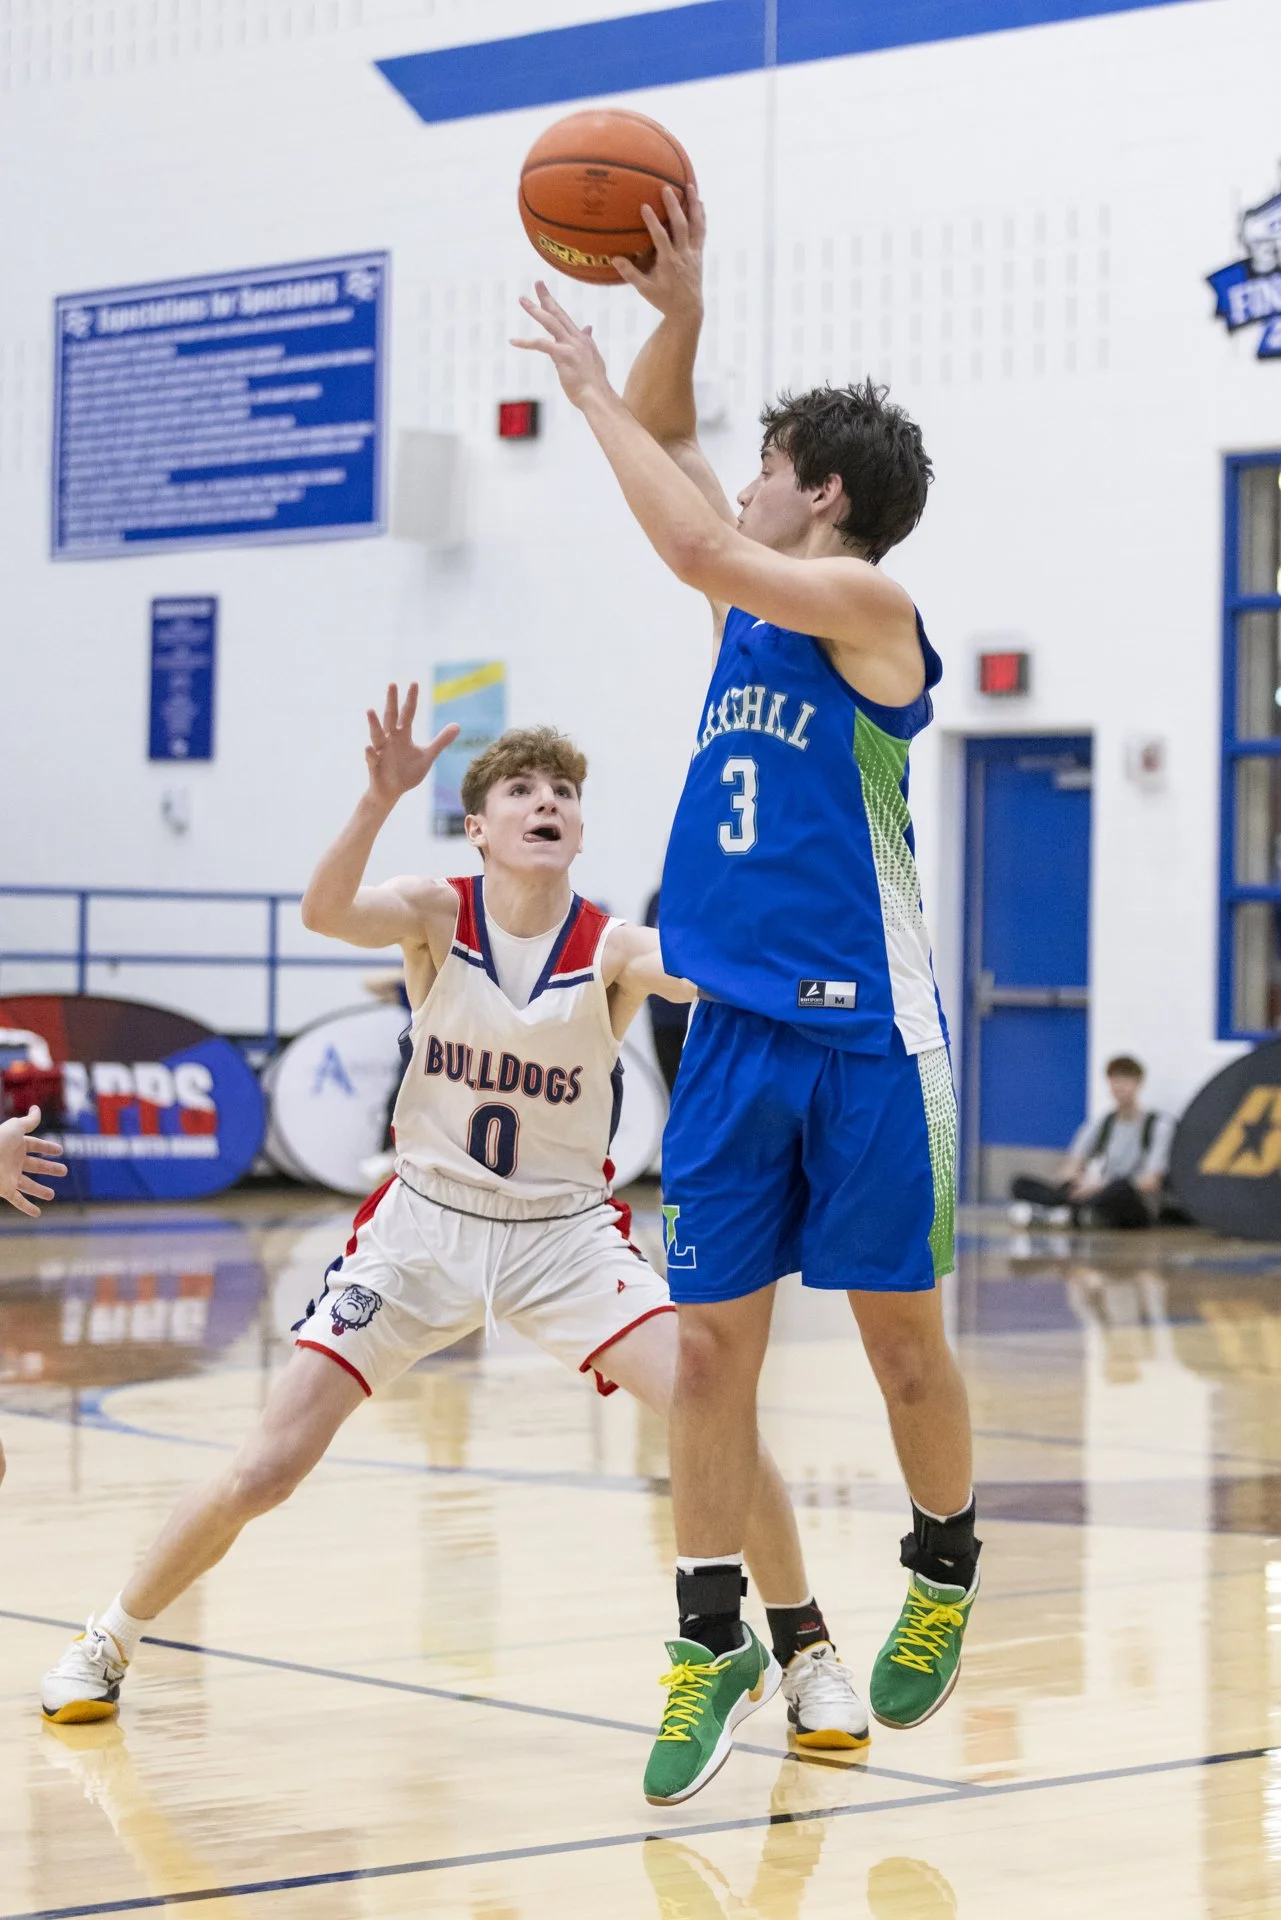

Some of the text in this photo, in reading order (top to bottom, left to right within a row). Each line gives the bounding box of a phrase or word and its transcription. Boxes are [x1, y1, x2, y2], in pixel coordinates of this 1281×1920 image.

[718, 755, 758, 856] 3
[834, 997, 845, 1005] M
[424, 1034, 584, 1106] BULLDOGS
[465, 1101, 521, 1180] 0
[661, 1204, 697, 1270] L
